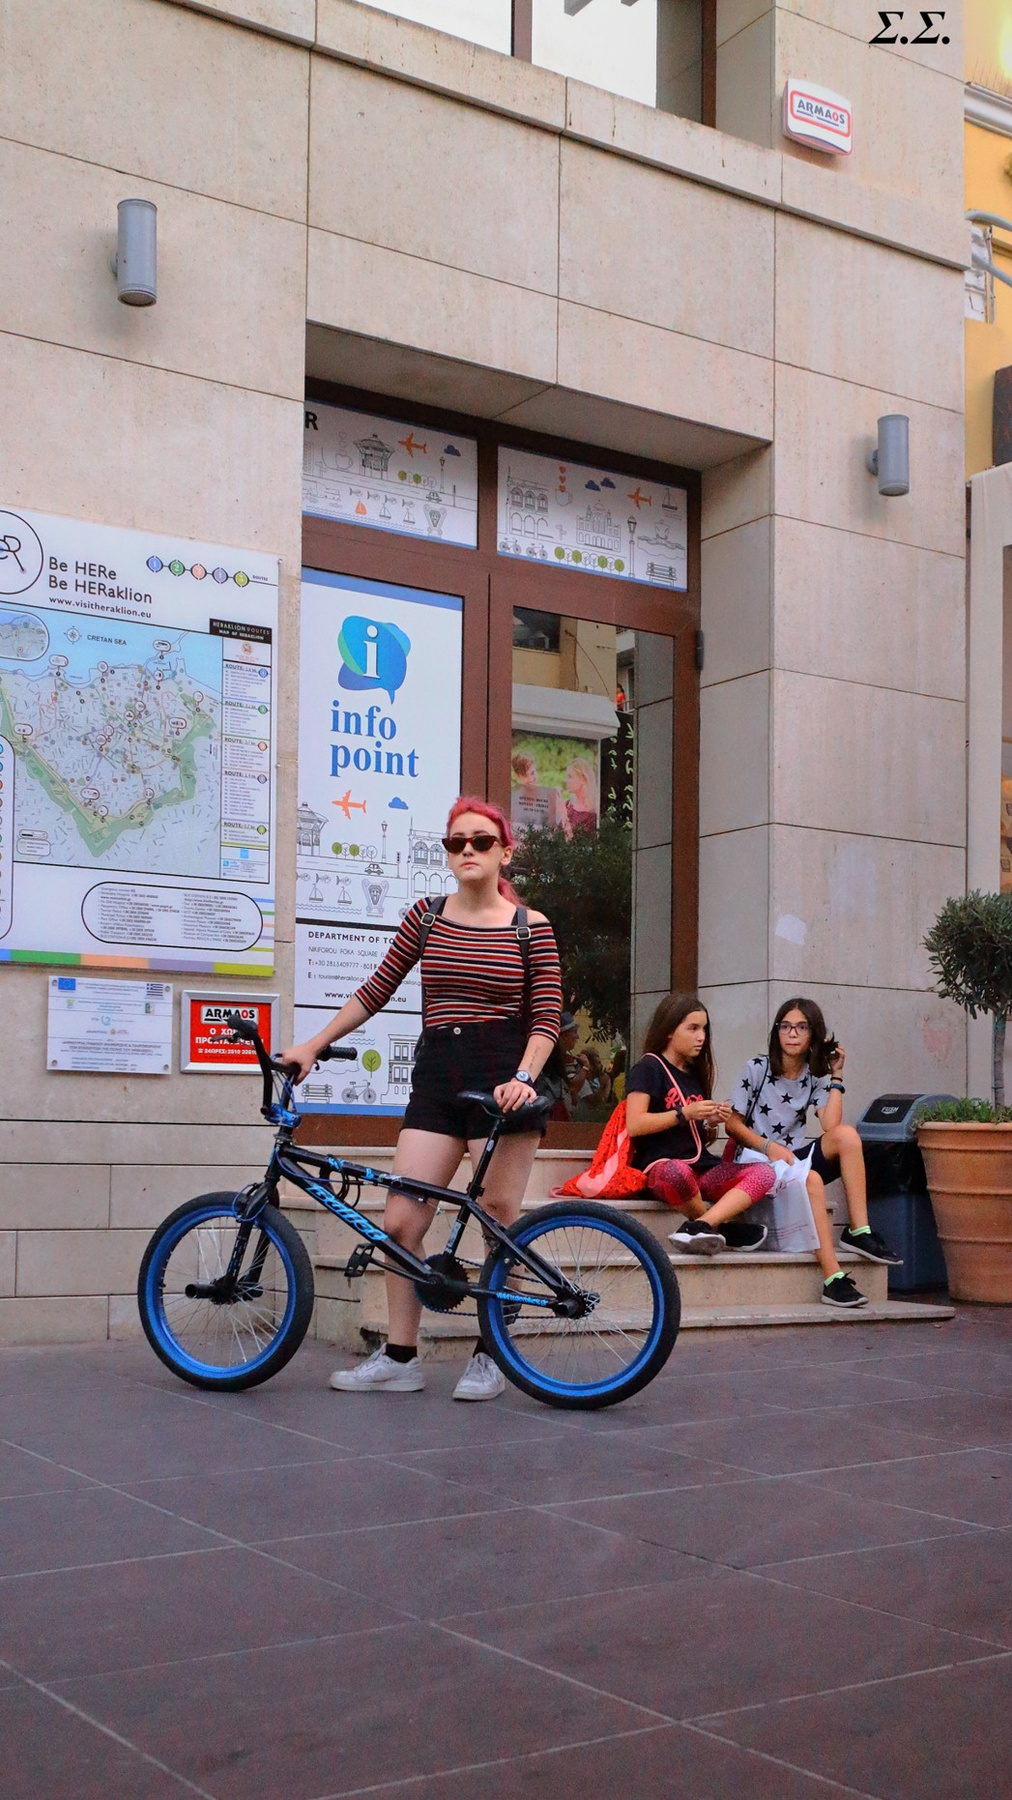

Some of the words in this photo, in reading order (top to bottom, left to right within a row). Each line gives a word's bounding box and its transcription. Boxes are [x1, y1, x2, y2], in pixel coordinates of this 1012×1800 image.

[797, 99, 846, 125] ARMAOS
[49, 556, 68, 573] Be
[75, 560, 117, 580] HERe
[49, 575, 68, 590] Be
[75, 579, 152, 604] HERaklion
[49, 596, 152, 619] www.visitheraklion.eu
[87, 634, 113, 644] CRETAN
[114, 638, 127, 646] SEA
[330, 699, 397, 741] info
[329, 740, 420, 778] point
[308, 931, 366, 942] DEPARTMENT
[368, 936, 380, 944] OF
[340, 948, 355, 956] FOKA
[357, 949, 378, 957] SQUARE
[205, 1007, 256, 1020] ARMAOS
